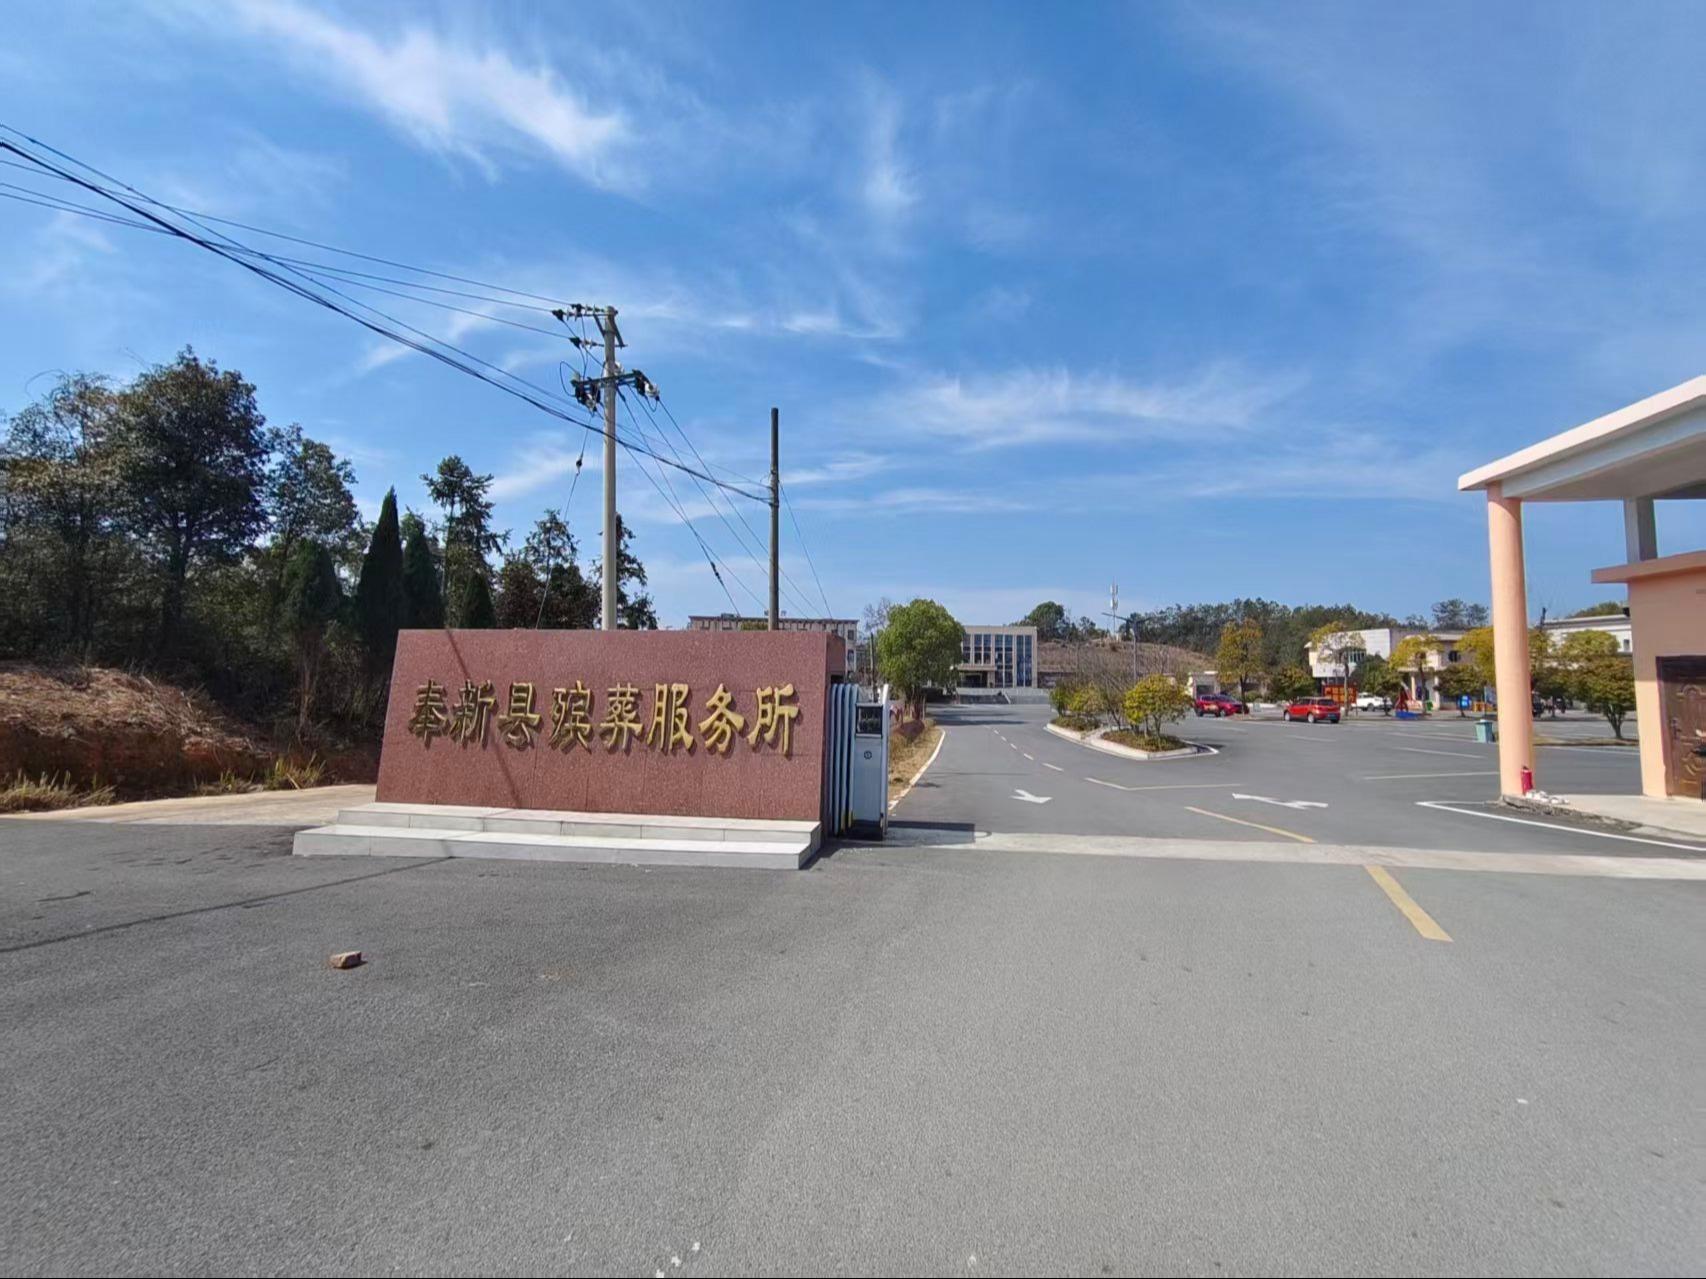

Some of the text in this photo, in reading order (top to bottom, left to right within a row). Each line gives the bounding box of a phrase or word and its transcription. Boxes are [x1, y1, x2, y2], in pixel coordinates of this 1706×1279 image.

[409, 680, 799, 756] 奉新县殡葬服务所
